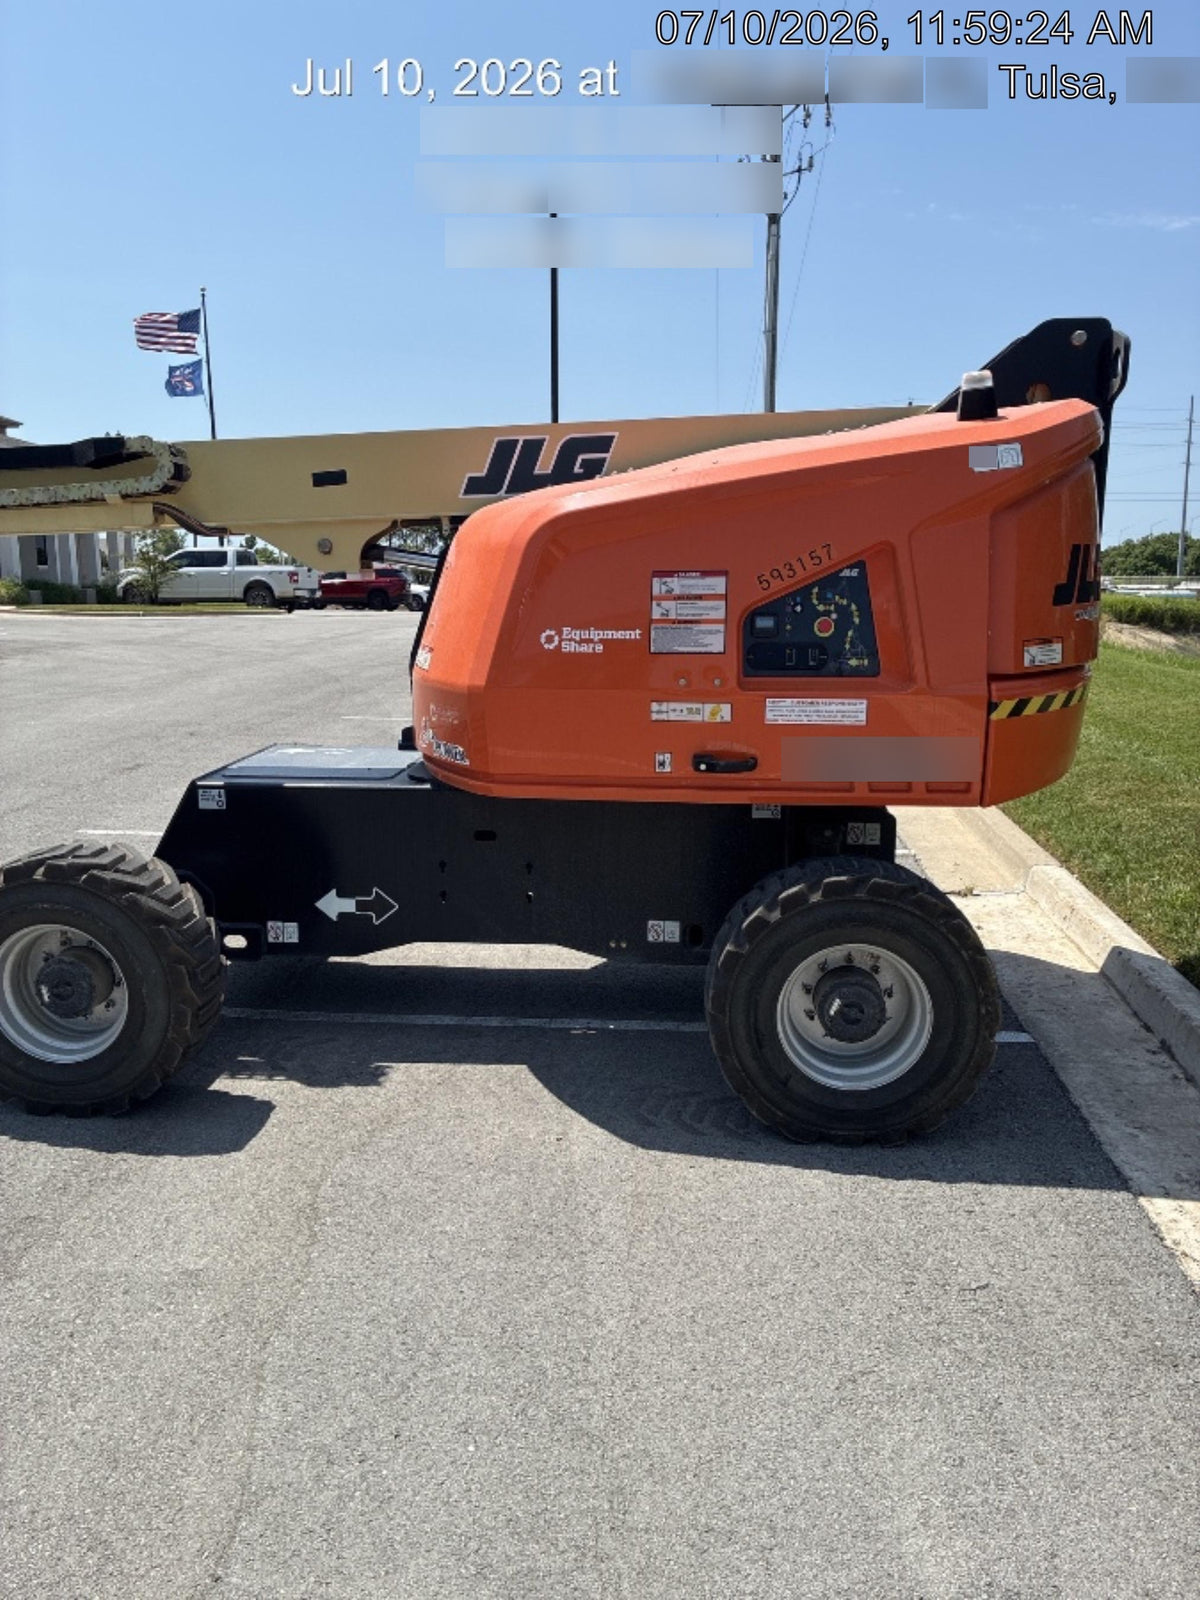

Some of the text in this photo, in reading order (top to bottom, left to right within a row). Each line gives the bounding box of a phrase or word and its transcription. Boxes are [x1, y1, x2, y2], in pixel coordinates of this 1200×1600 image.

[458, 432, 619, 498] JLG
[757, 543, 832, 591] 593157
[561, 626, 642, 642] Equipment
[561, 640, 604, 654] Share
